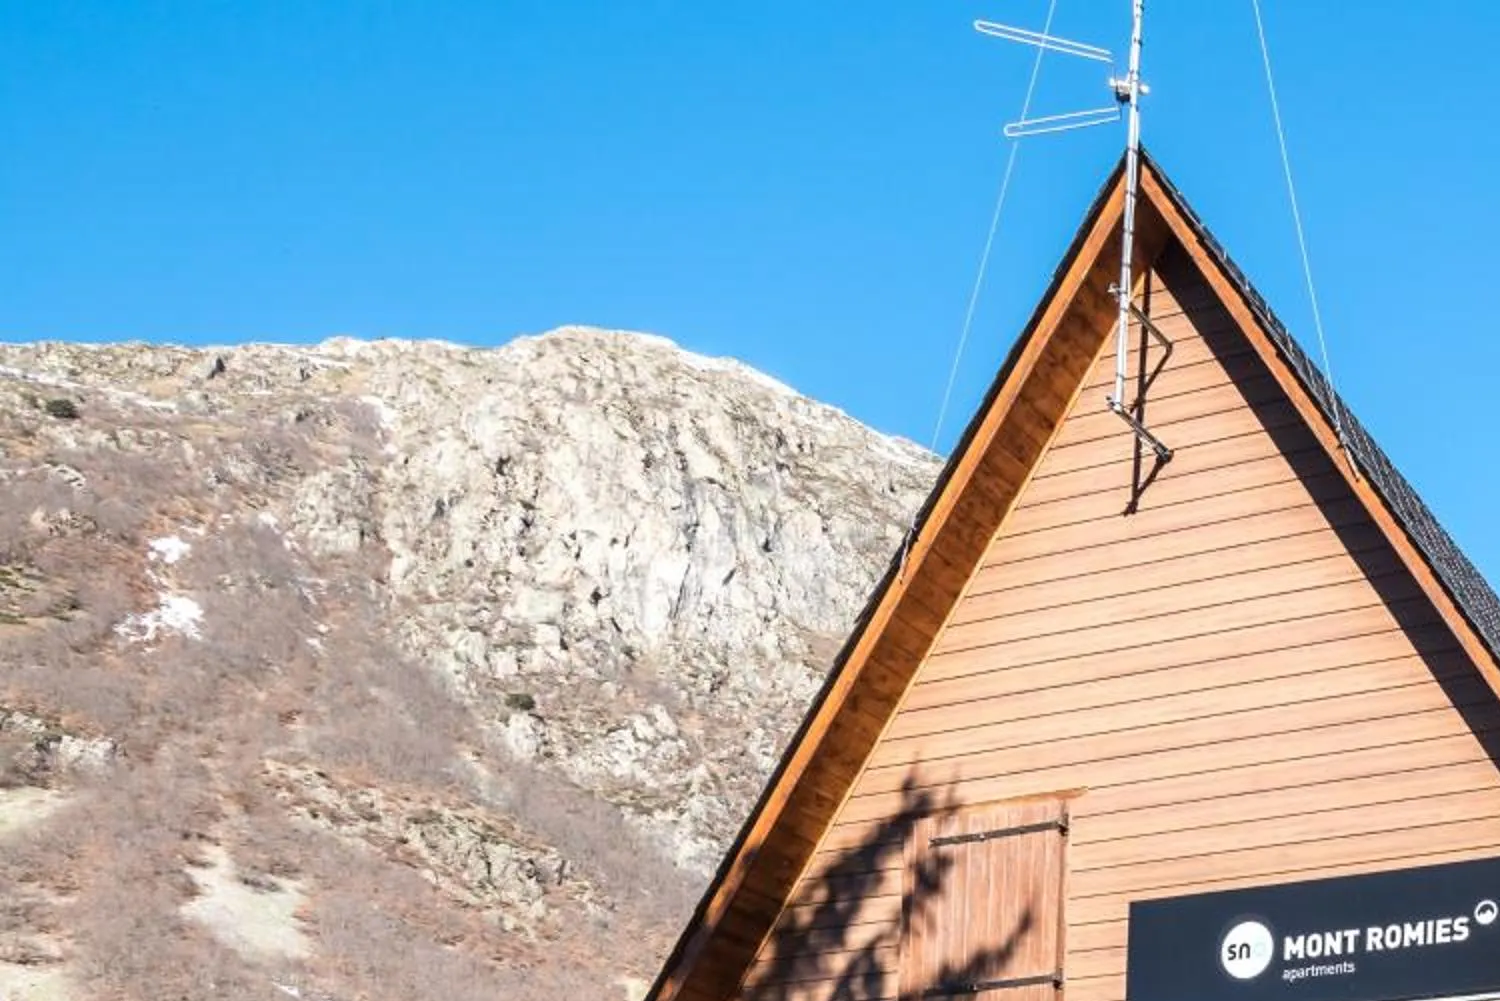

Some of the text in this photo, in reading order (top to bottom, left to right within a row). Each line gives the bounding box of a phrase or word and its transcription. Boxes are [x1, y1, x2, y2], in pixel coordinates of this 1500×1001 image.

[1283, 916, 1470, 961] MONT ROMIES
[1282, 961, 1356, 982] apartments
